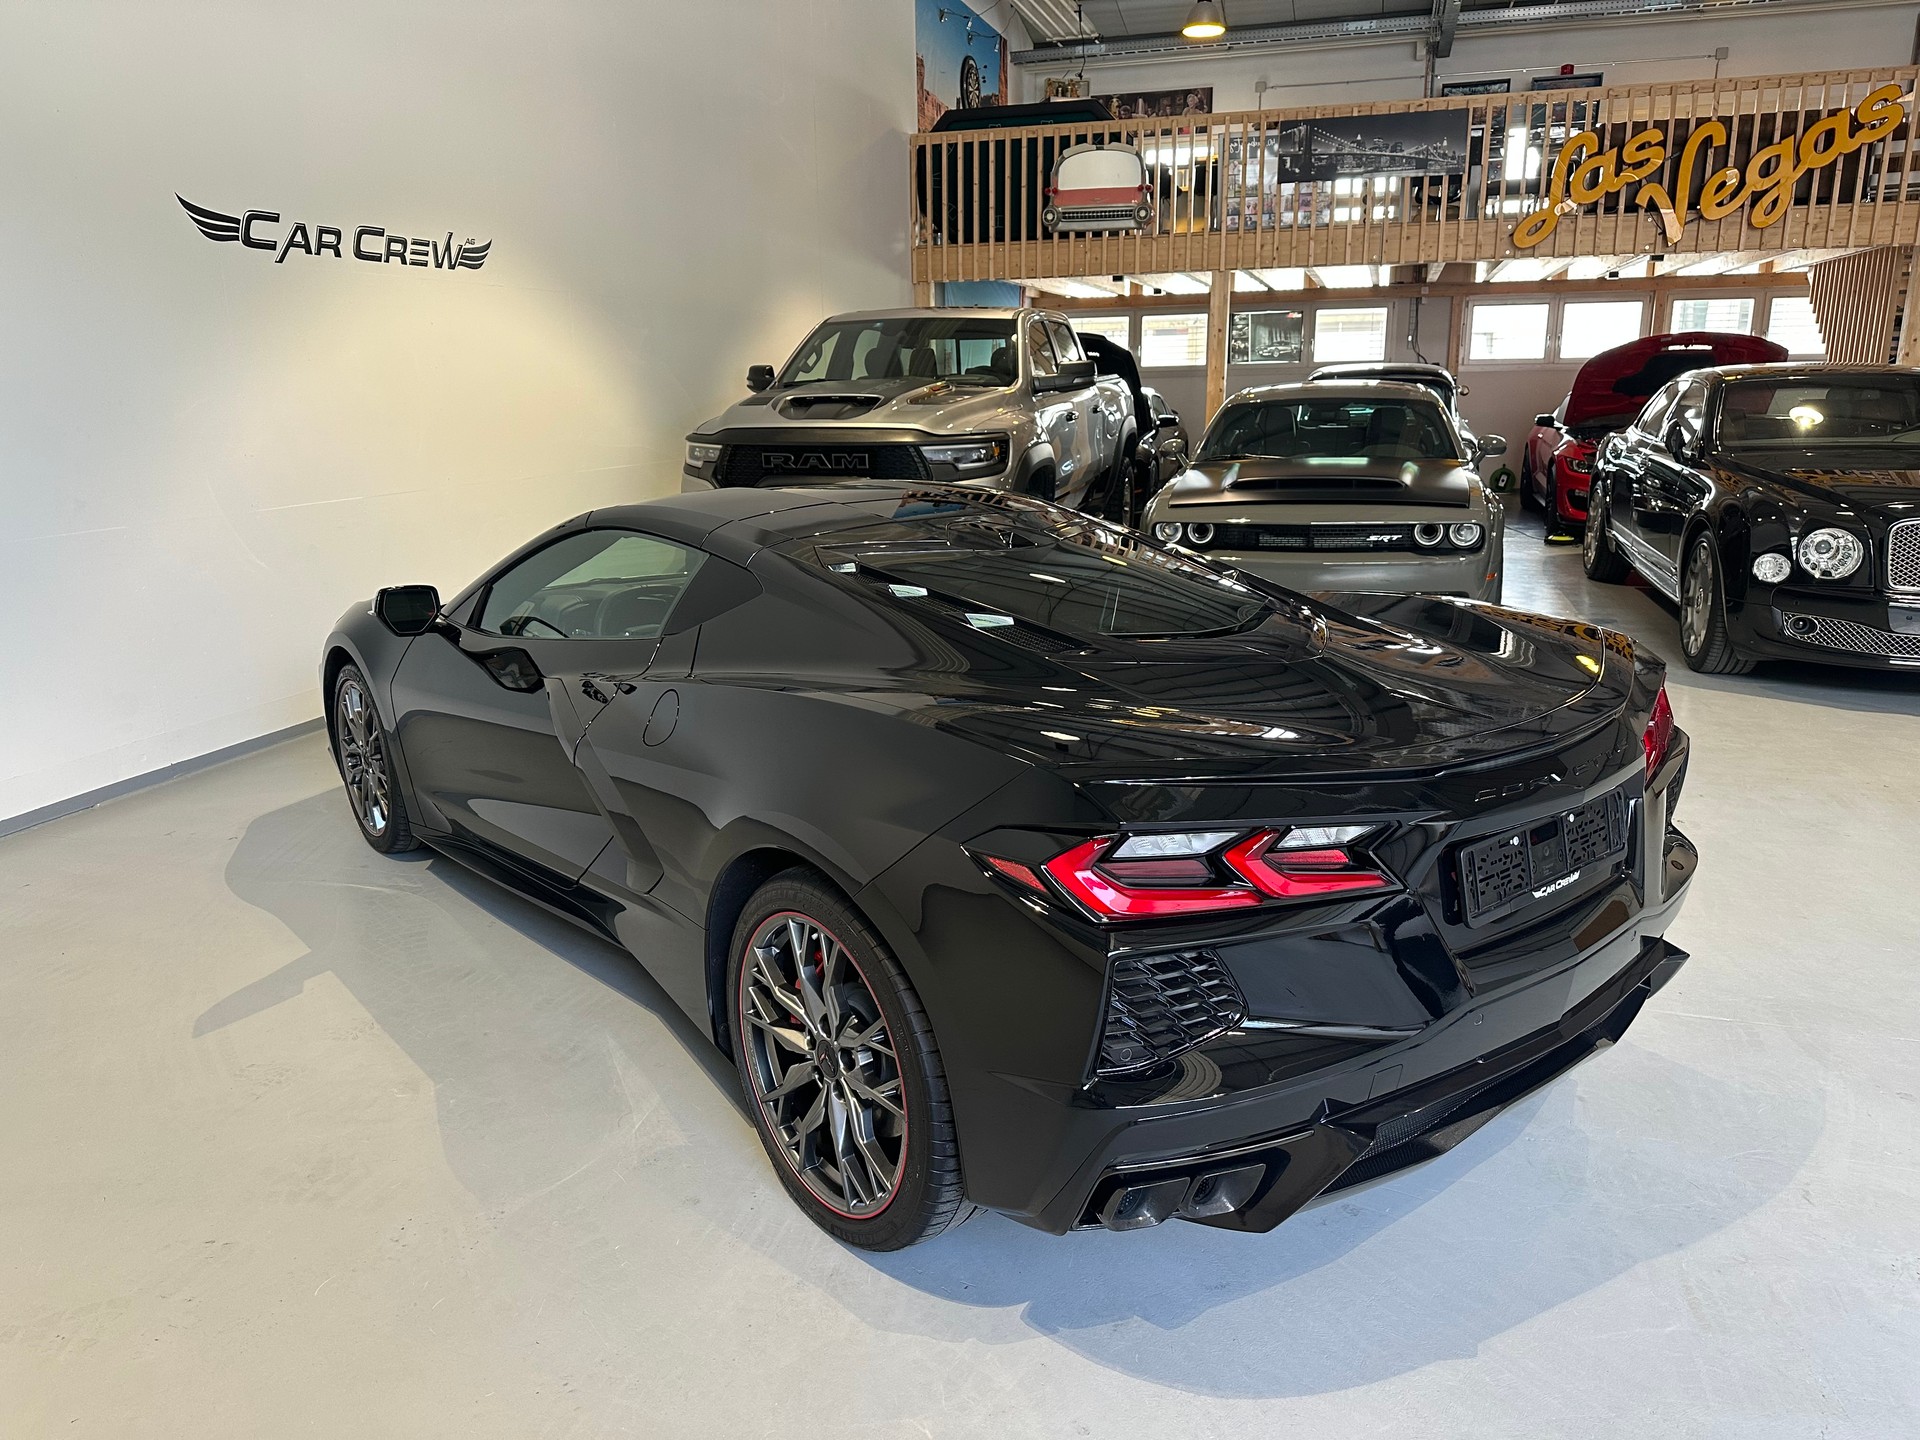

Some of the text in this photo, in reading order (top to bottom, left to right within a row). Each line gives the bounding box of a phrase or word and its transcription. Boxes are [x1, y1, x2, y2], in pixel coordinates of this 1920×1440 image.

[1513, 83, 1904, 249] Las Vegas
[240, 208, 342, 264] CAR
[353, 224, 463, 270] CREW
[761, 452, 869, 469] RAM
[1366, 534, 1403, 543] SRT
[1540, 883, 1556, 897] CAR
